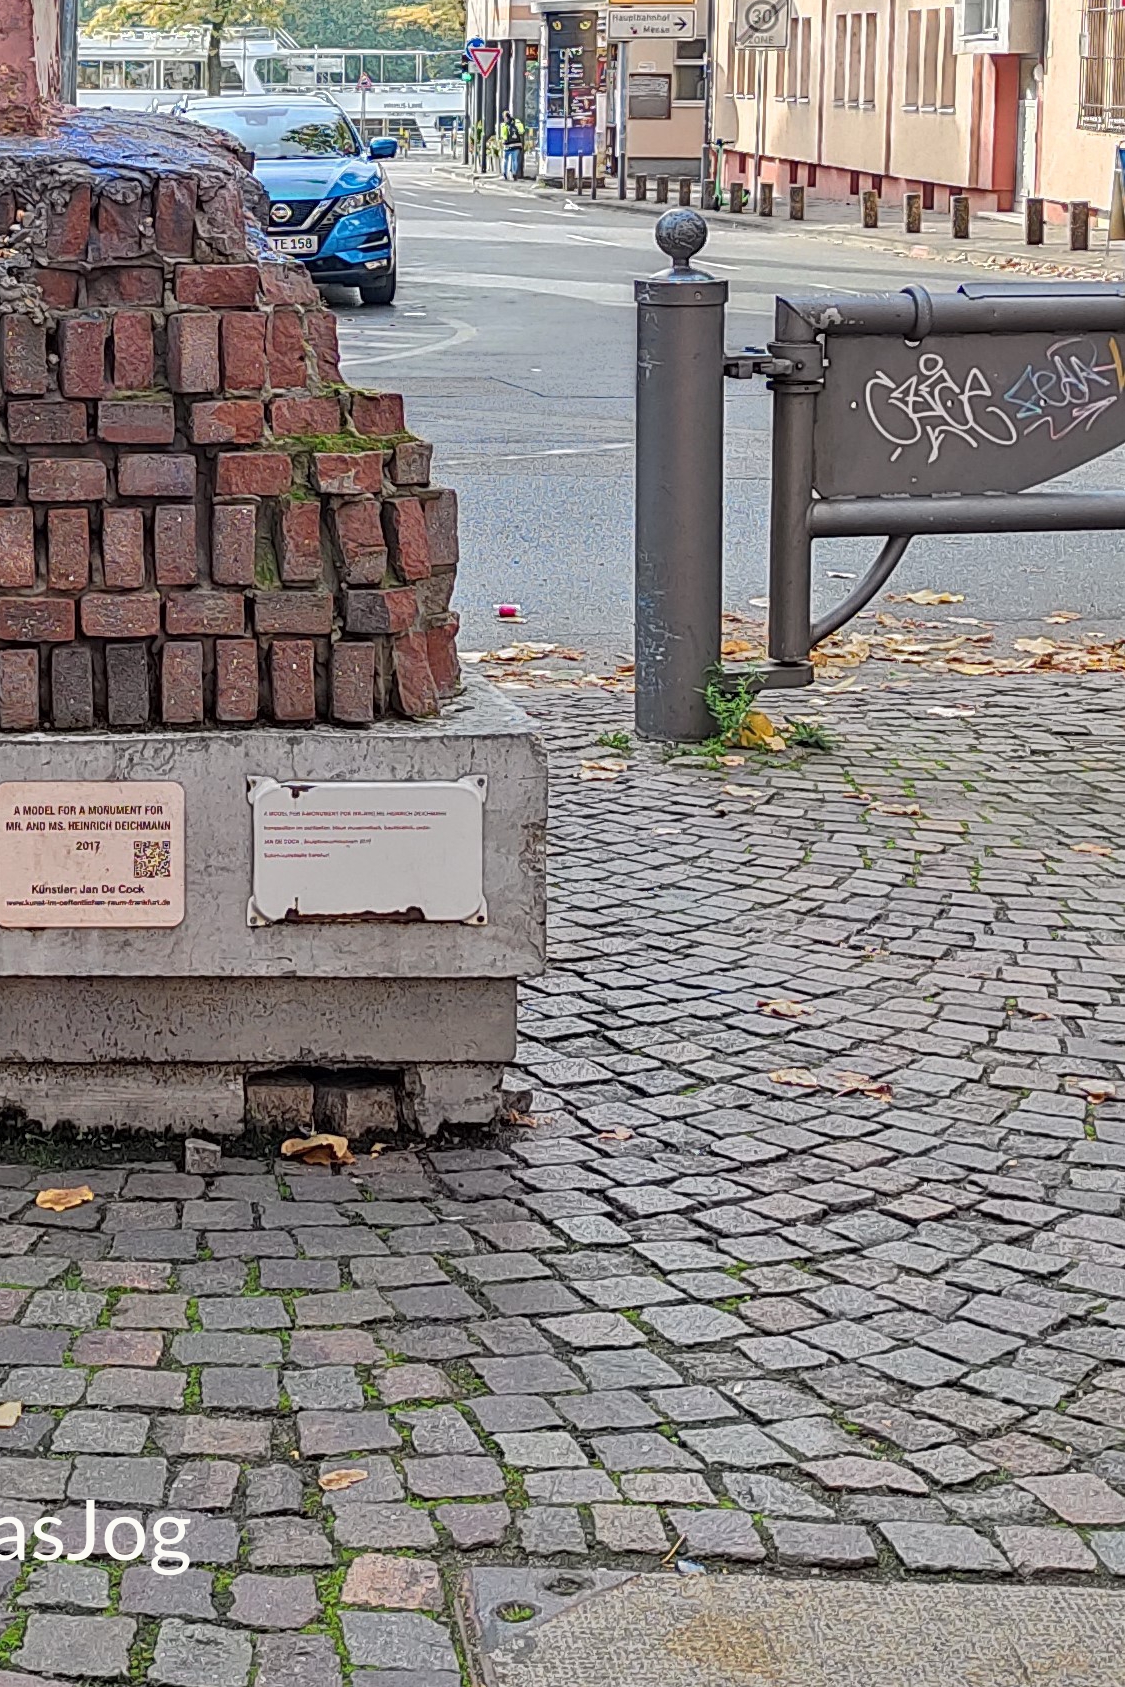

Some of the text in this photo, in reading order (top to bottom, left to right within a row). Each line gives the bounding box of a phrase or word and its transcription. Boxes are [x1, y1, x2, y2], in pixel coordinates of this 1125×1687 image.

[752, 8, 772, 24] 30
[13, 805, 163, 816] A MODEL FOR A MONUMENT FOR
[6, 821, 171, 831] MR. AND MS. HEINRICH DEICHMANN
[76, 841, 101, 851] 2017
[80, 884, 99, 894] Jan
[101, 884, 115, 894] De
[118, 883, 145, 894] Cock
